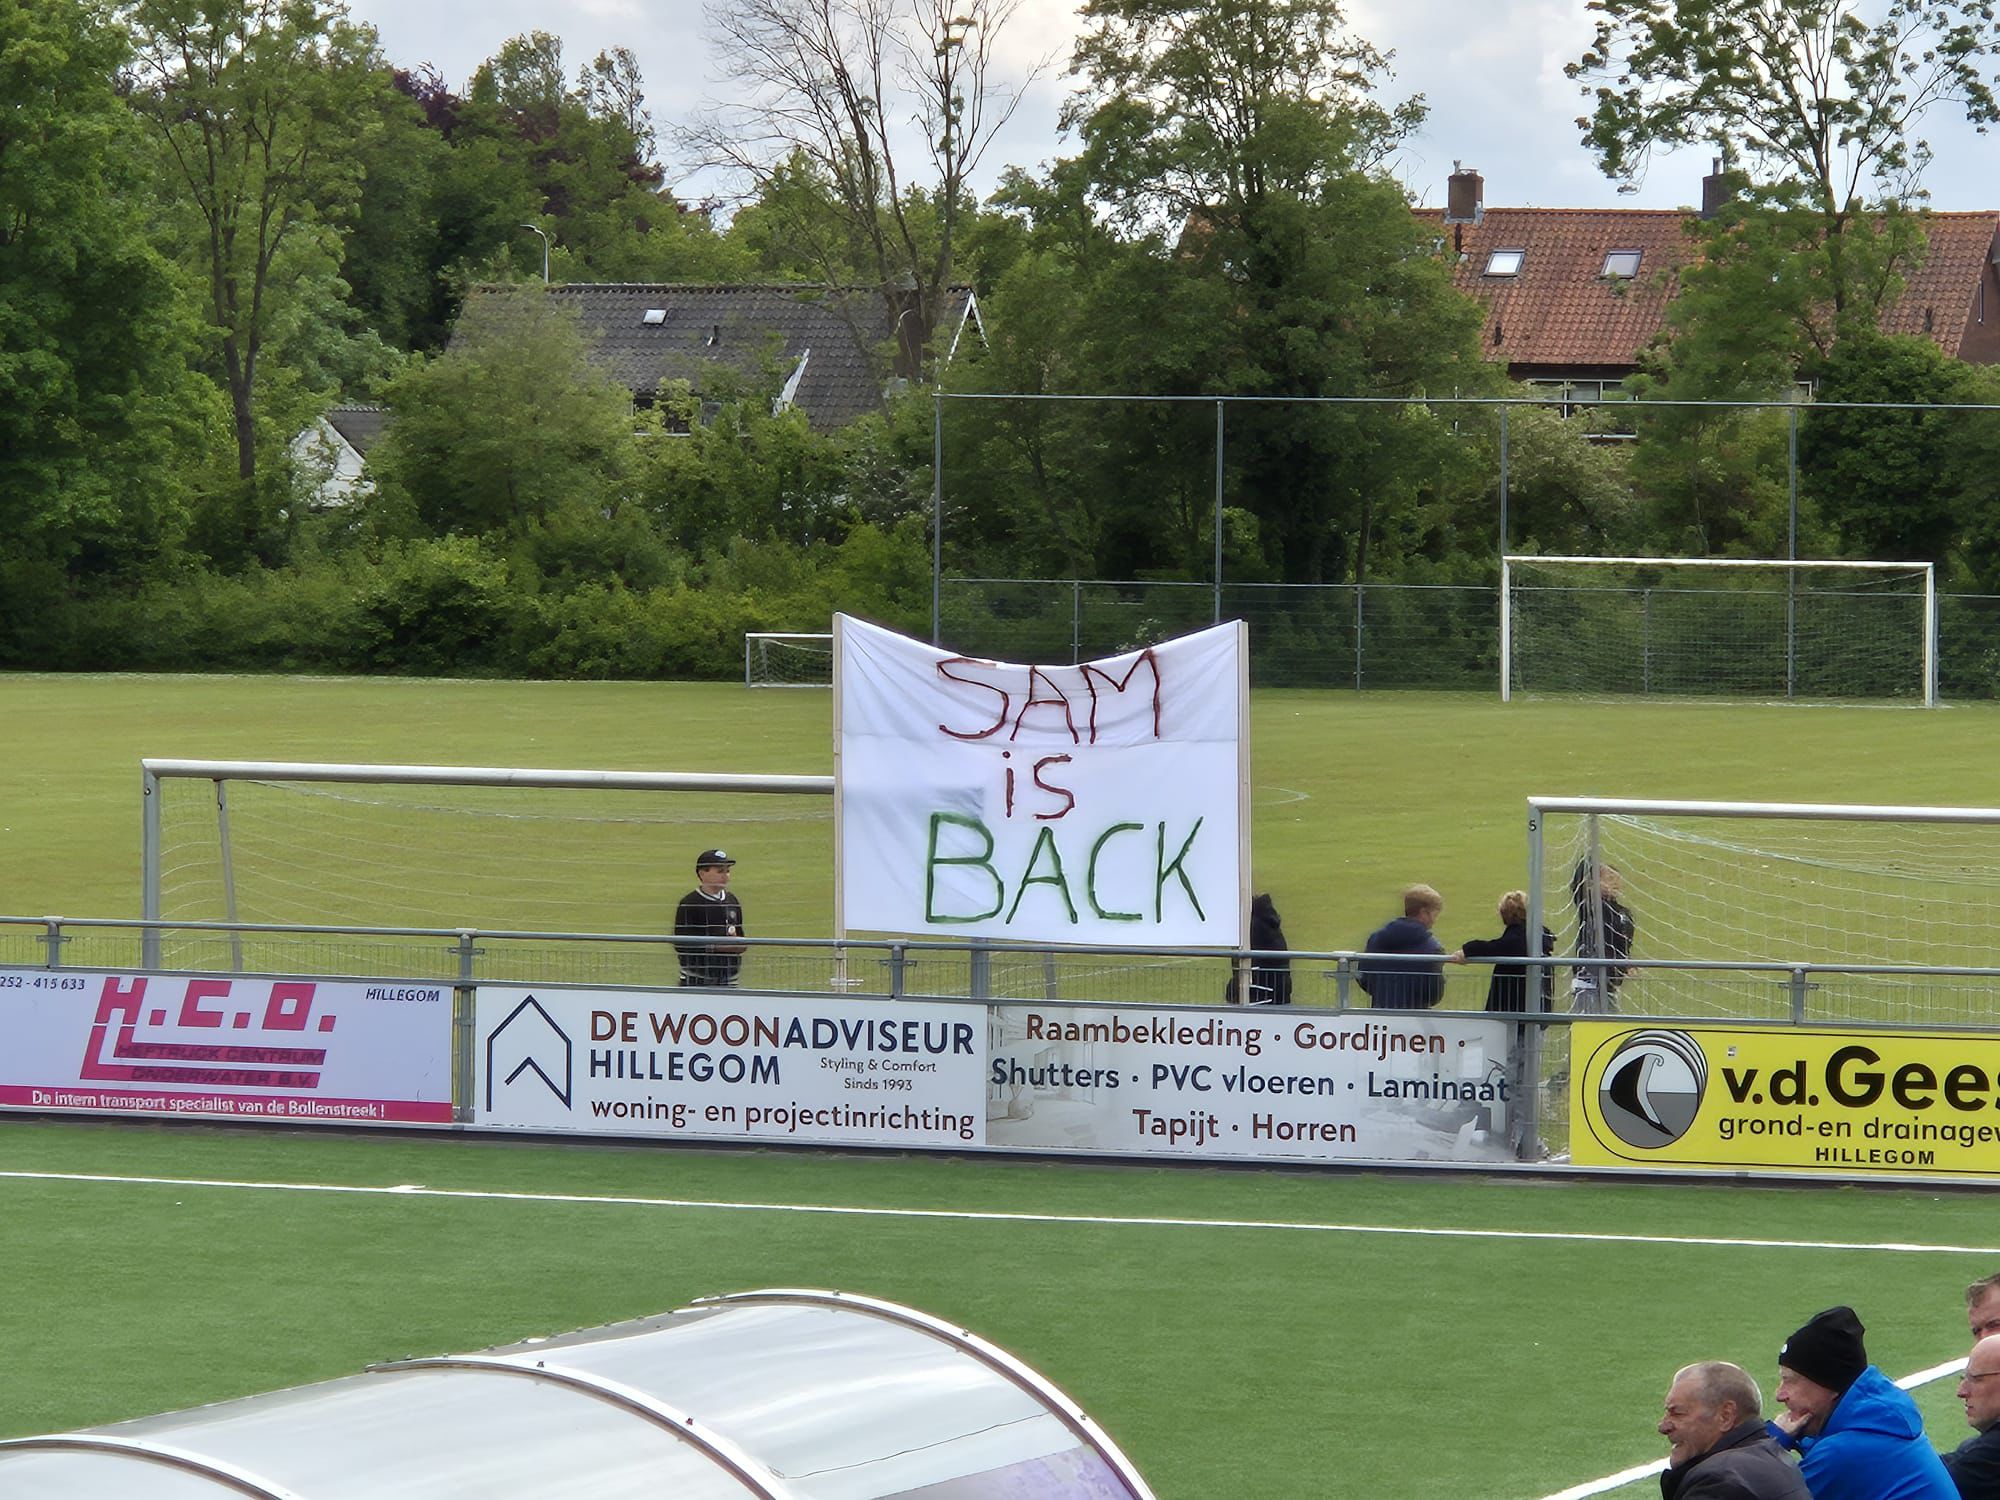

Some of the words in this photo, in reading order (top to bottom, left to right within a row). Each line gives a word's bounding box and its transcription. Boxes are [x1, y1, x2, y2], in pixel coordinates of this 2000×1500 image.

[936, 647, 1160, 744] SAM
[925, 811, 1206, 925] BACK
[365, 988, 441, 1002] HILLEGOM
[591, 1010, 638, 1042] DE
[649, 1013, 974, 1055] WOONADVISEUR
[1026, 1014, 1263, 1056] Raambekleding
[1293, 1023, 1446, 1062] Gordijnen
[590, 1050, 780, 1085] HILLEGOM
[820, 1057, 864, 1074] Styling
[867, 1059, 878, 1070] &
[881, 1059, 937, 1073] Comfort
[844, 1077, 879, 1090] Sinds
[882, 1079, 913, 1091] 1993
[991, 1058, 1120, 1090] Shutters
[1152, 1064, 1212, 1092] PVC
[1222, 1067, 1335, 1096] vloeren
[1367, 1070, 1511, 1103] Laminaat
[32, 1090, 51, 1105] De
[55, 1091, 97, 1107] intern
[100, 1094, 166, 1110] transport
[169, 1097, 235, 1112] specialist
[238, 1102, 263, 1113] van
[267, 1100, 285, 1114] de
[591, 1096, 696, 1128] woning-
[706, 1103, 737, 1123] en
[745, 1104, 976, 1140] projectinrichting
[1132, 1109, 1219, 1151] Tapijt
[1252, 1113, 1357, 1143] Horren
[1719, 1114, 1851, 1140] grond-en
[1815, 1147, 1935, 1165] HILLEGOM
